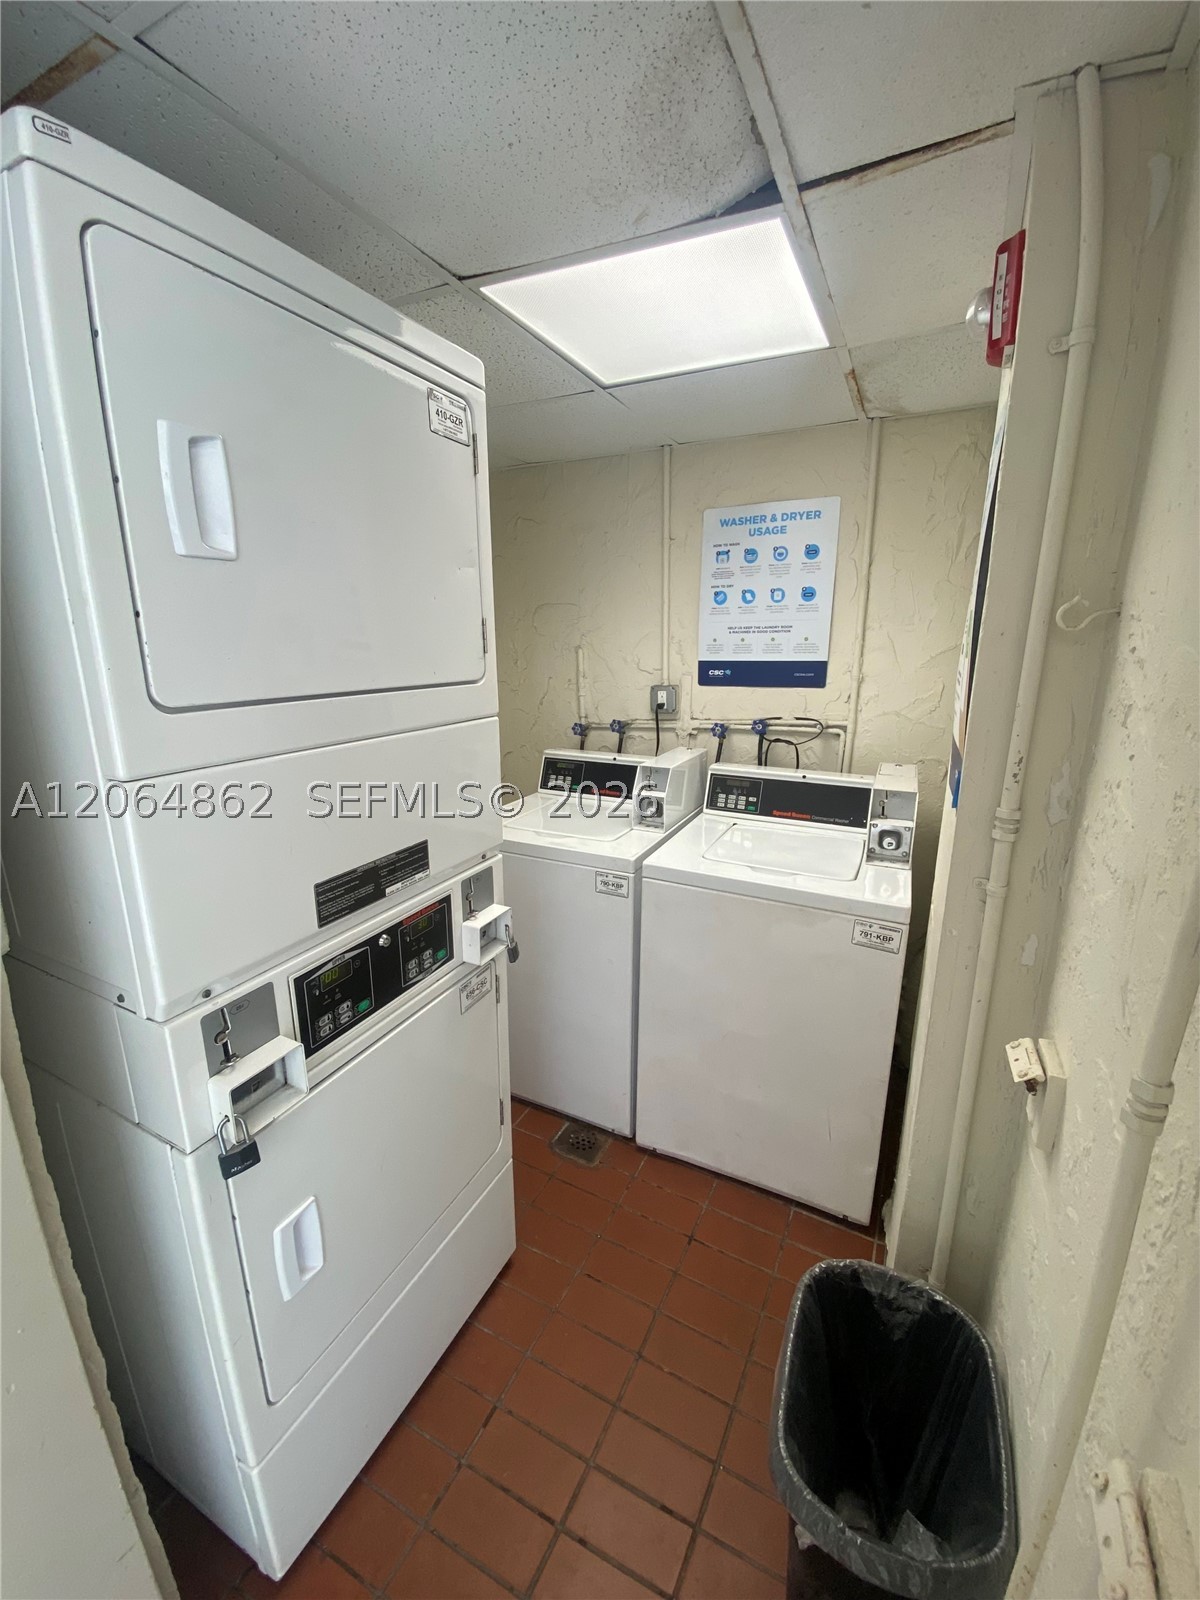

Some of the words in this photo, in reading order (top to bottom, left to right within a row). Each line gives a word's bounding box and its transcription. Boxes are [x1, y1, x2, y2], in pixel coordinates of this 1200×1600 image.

[435, 408, 464, 428] 410-GZR
[719, 514, 767, 528] WASHER
[769, 513, 778, 522] &
[781, 510, 822, 522] DRYER
[748, 525, 788, 537] USAGE
[600, 880, 624, 889] 790-KBP
[859, 930, 894, 943] 791-KBP
